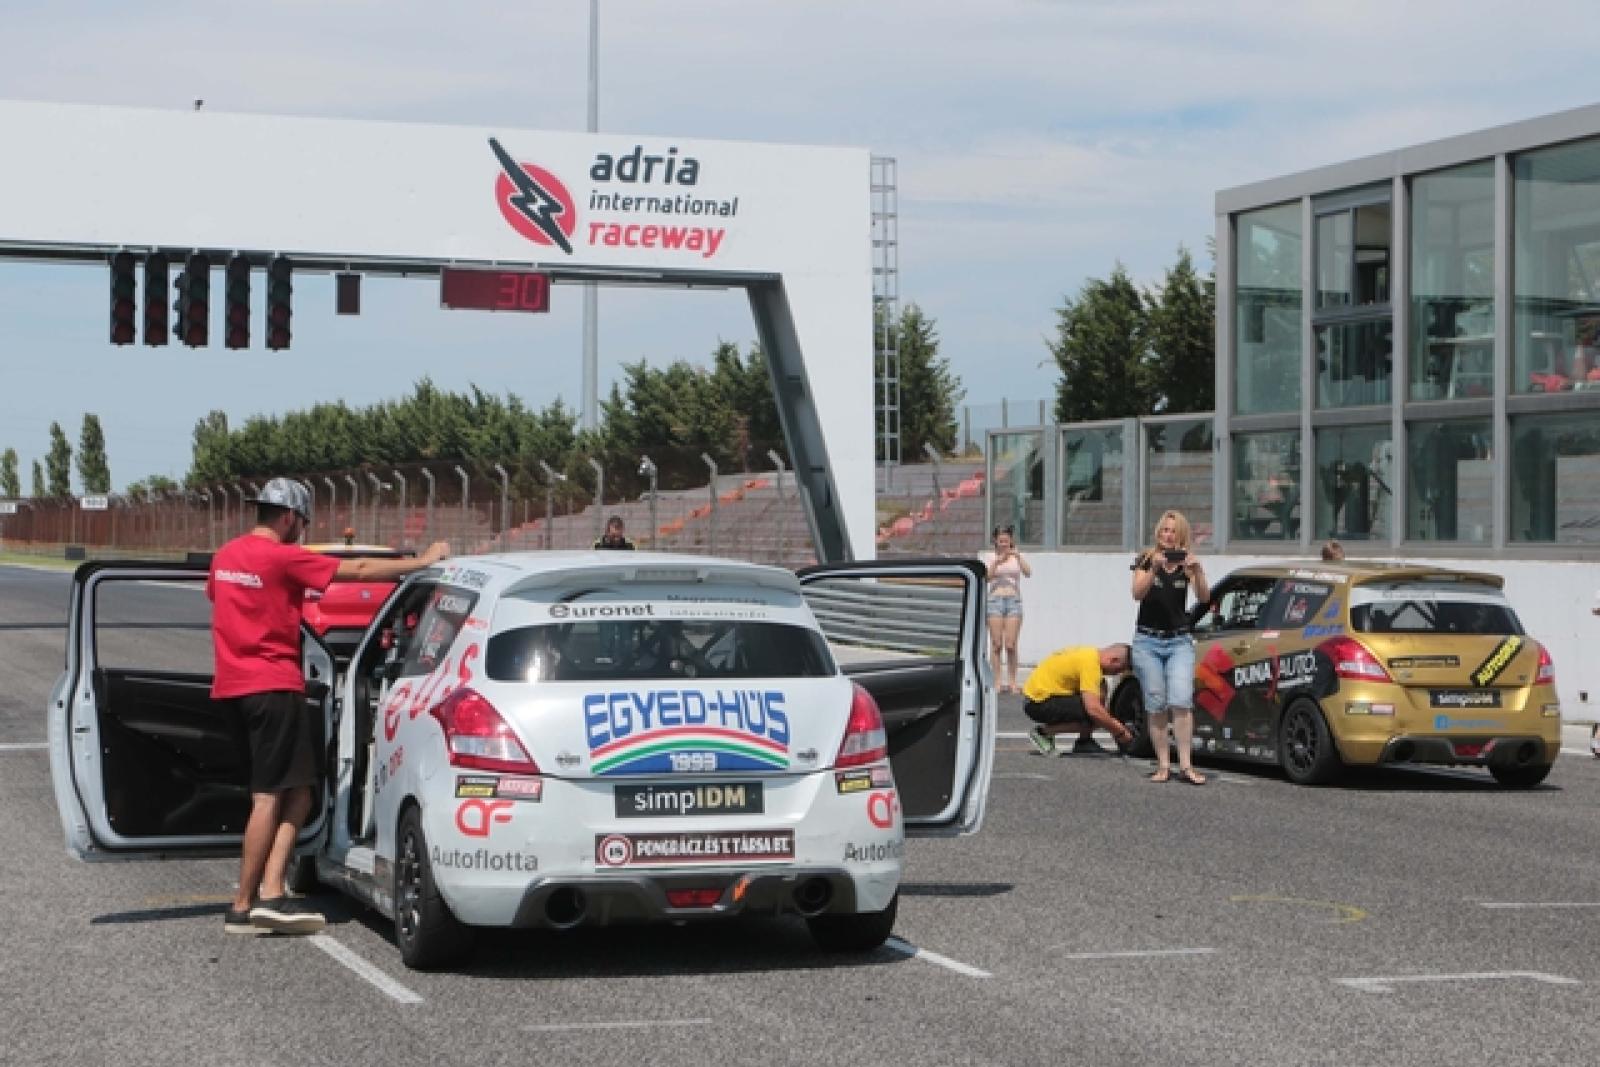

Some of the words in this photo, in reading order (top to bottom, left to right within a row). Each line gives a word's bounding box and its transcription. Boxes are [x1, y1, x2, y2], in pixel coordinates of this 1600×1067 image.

[590, 145, 701, 186] adria
[589, 190, 739, 218] international
[588, 222, 726, 258] raceway
[496, 274, 543, 310] 30
[634, 785, 746, 815] simpIDM
[430, 846, 539, 872] Autoflotta
